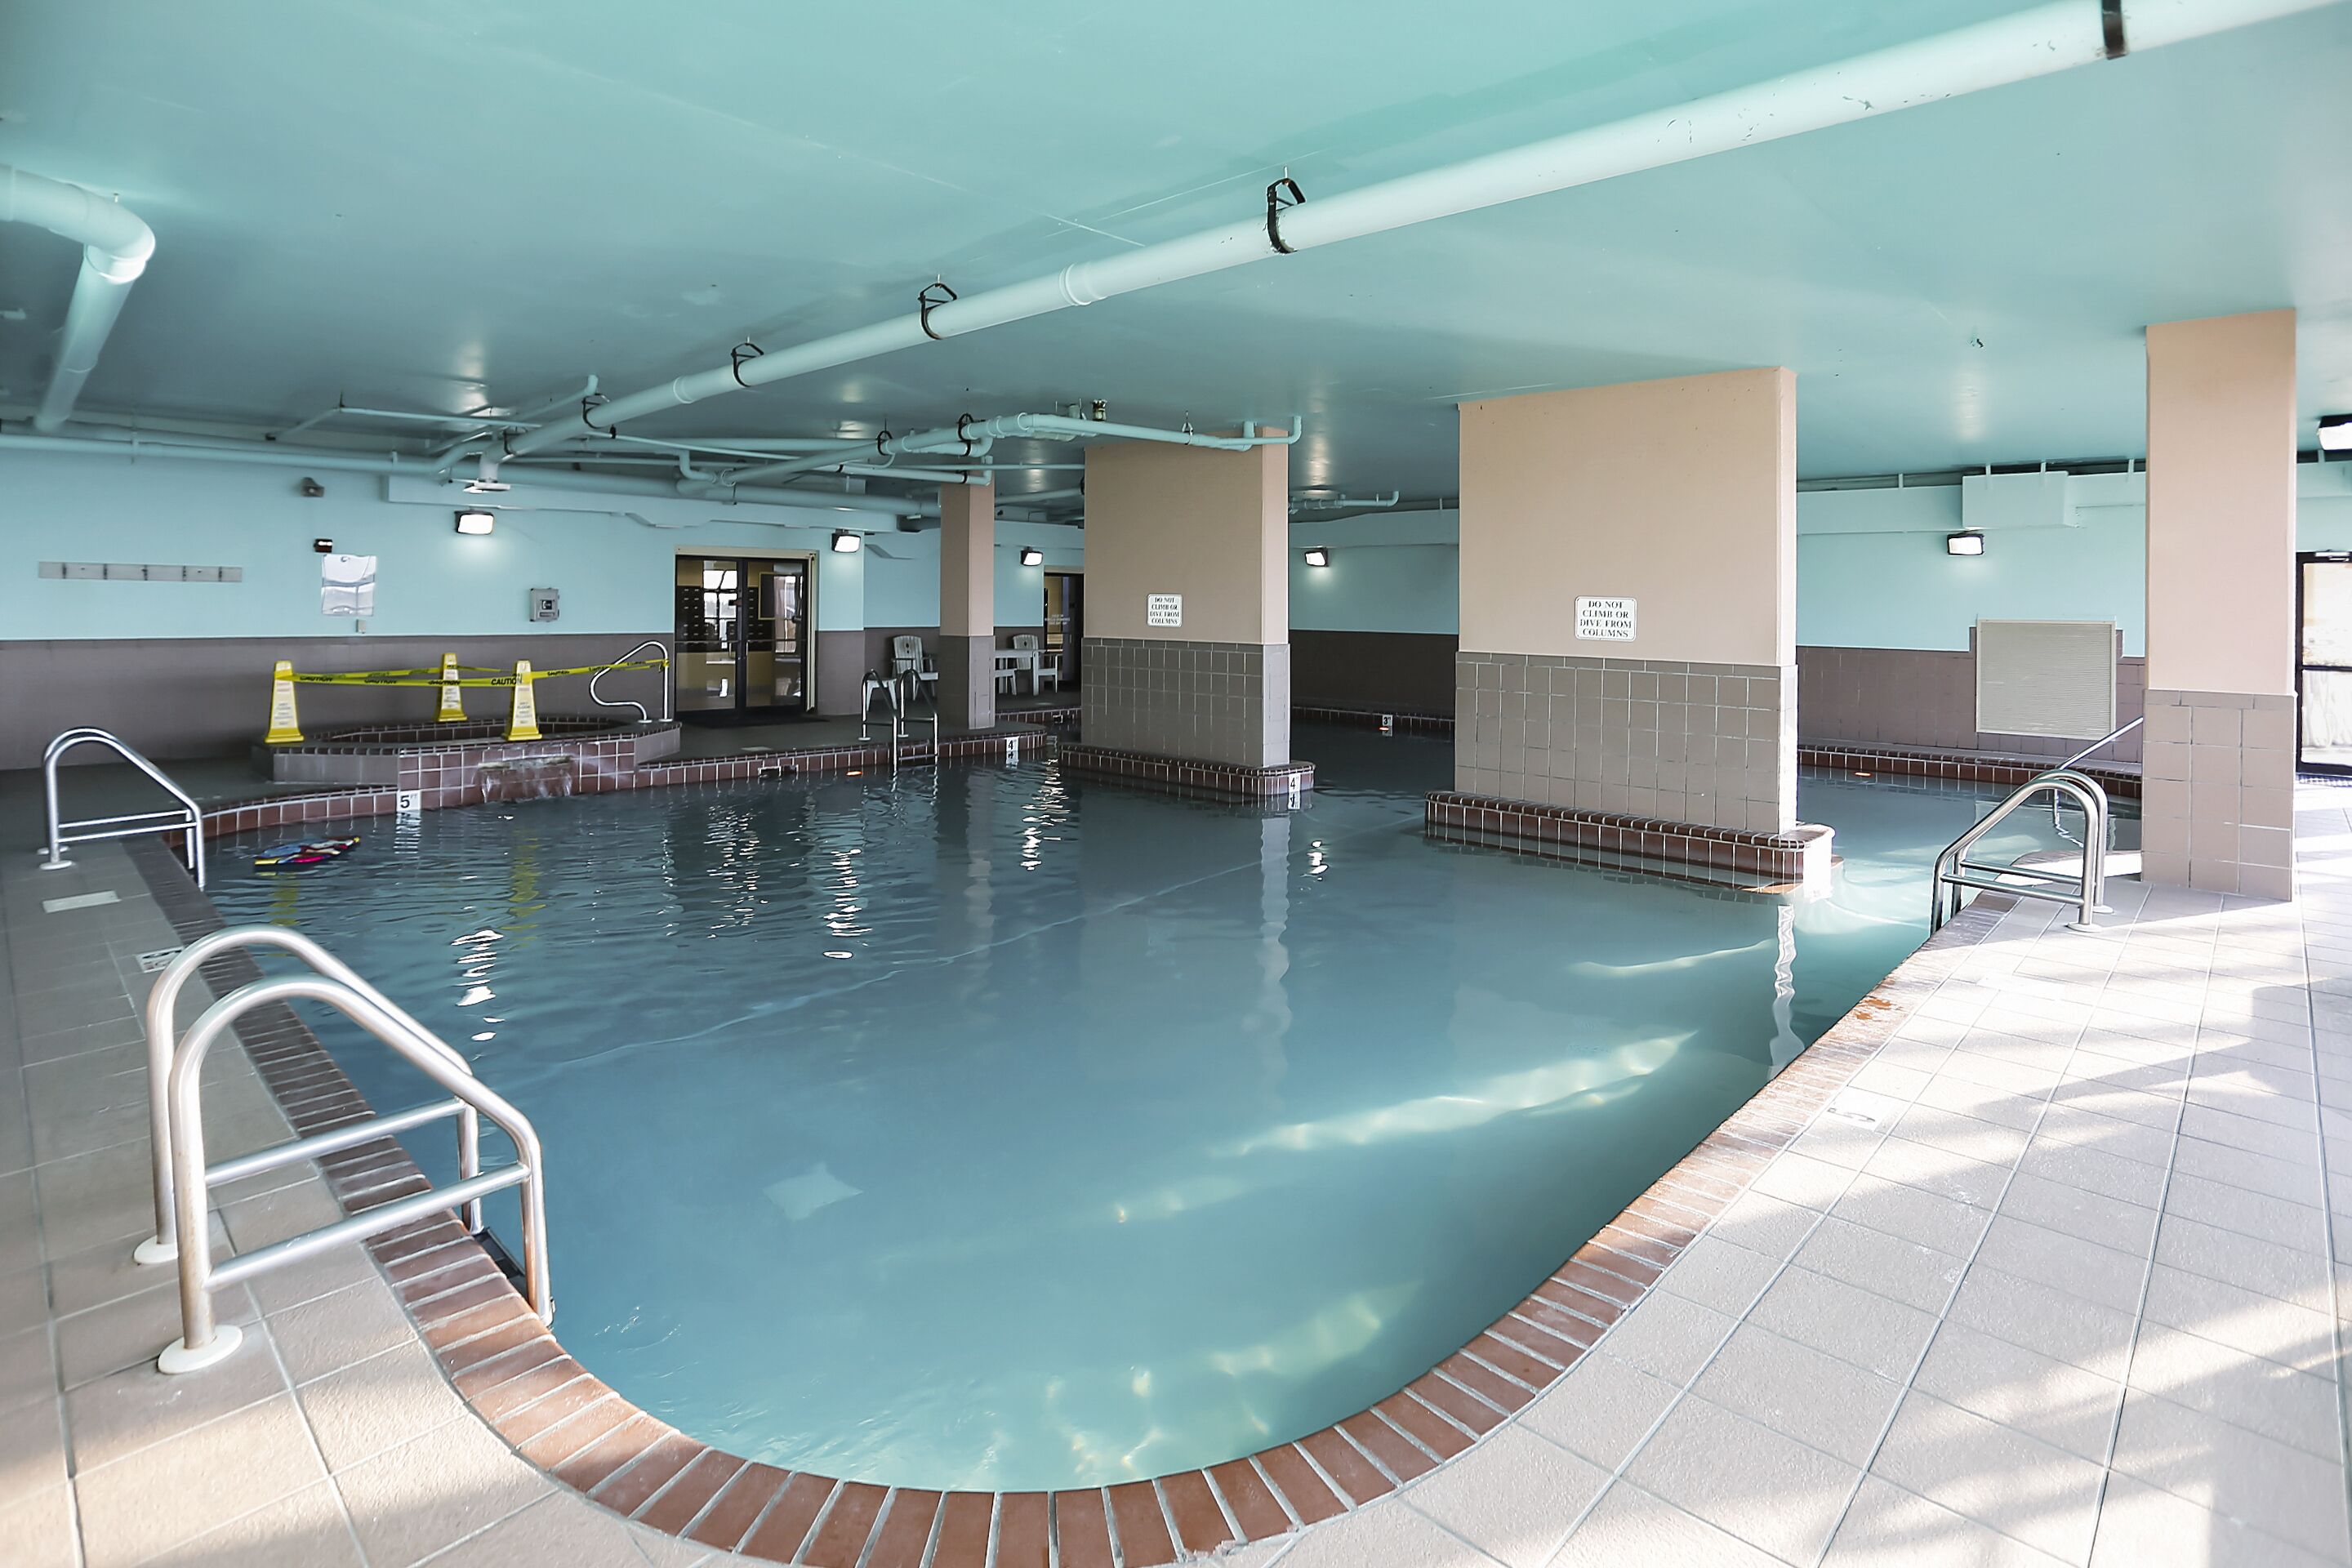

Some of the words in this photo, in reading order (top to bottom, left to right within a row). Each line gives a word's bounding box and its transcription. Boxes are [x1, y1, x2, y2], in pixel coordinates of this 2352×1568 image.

[1605, 601, 1624, 609] NOT
[1583, 609, 1613, 618] CLIMB
[1615, 610, 1629, 619] OR
[1579, 619, 1601, 627] DIVE
[1605, 620, 1633, 629] FROM
[1583, 628, 1629, 638] COLUMNS
[491, 673, 523, 686] CAUTION
[1008, 740, 1013, 750] 4
[1290, 777, 1296, 790] 4
[400, 795, 410, 808] 5
